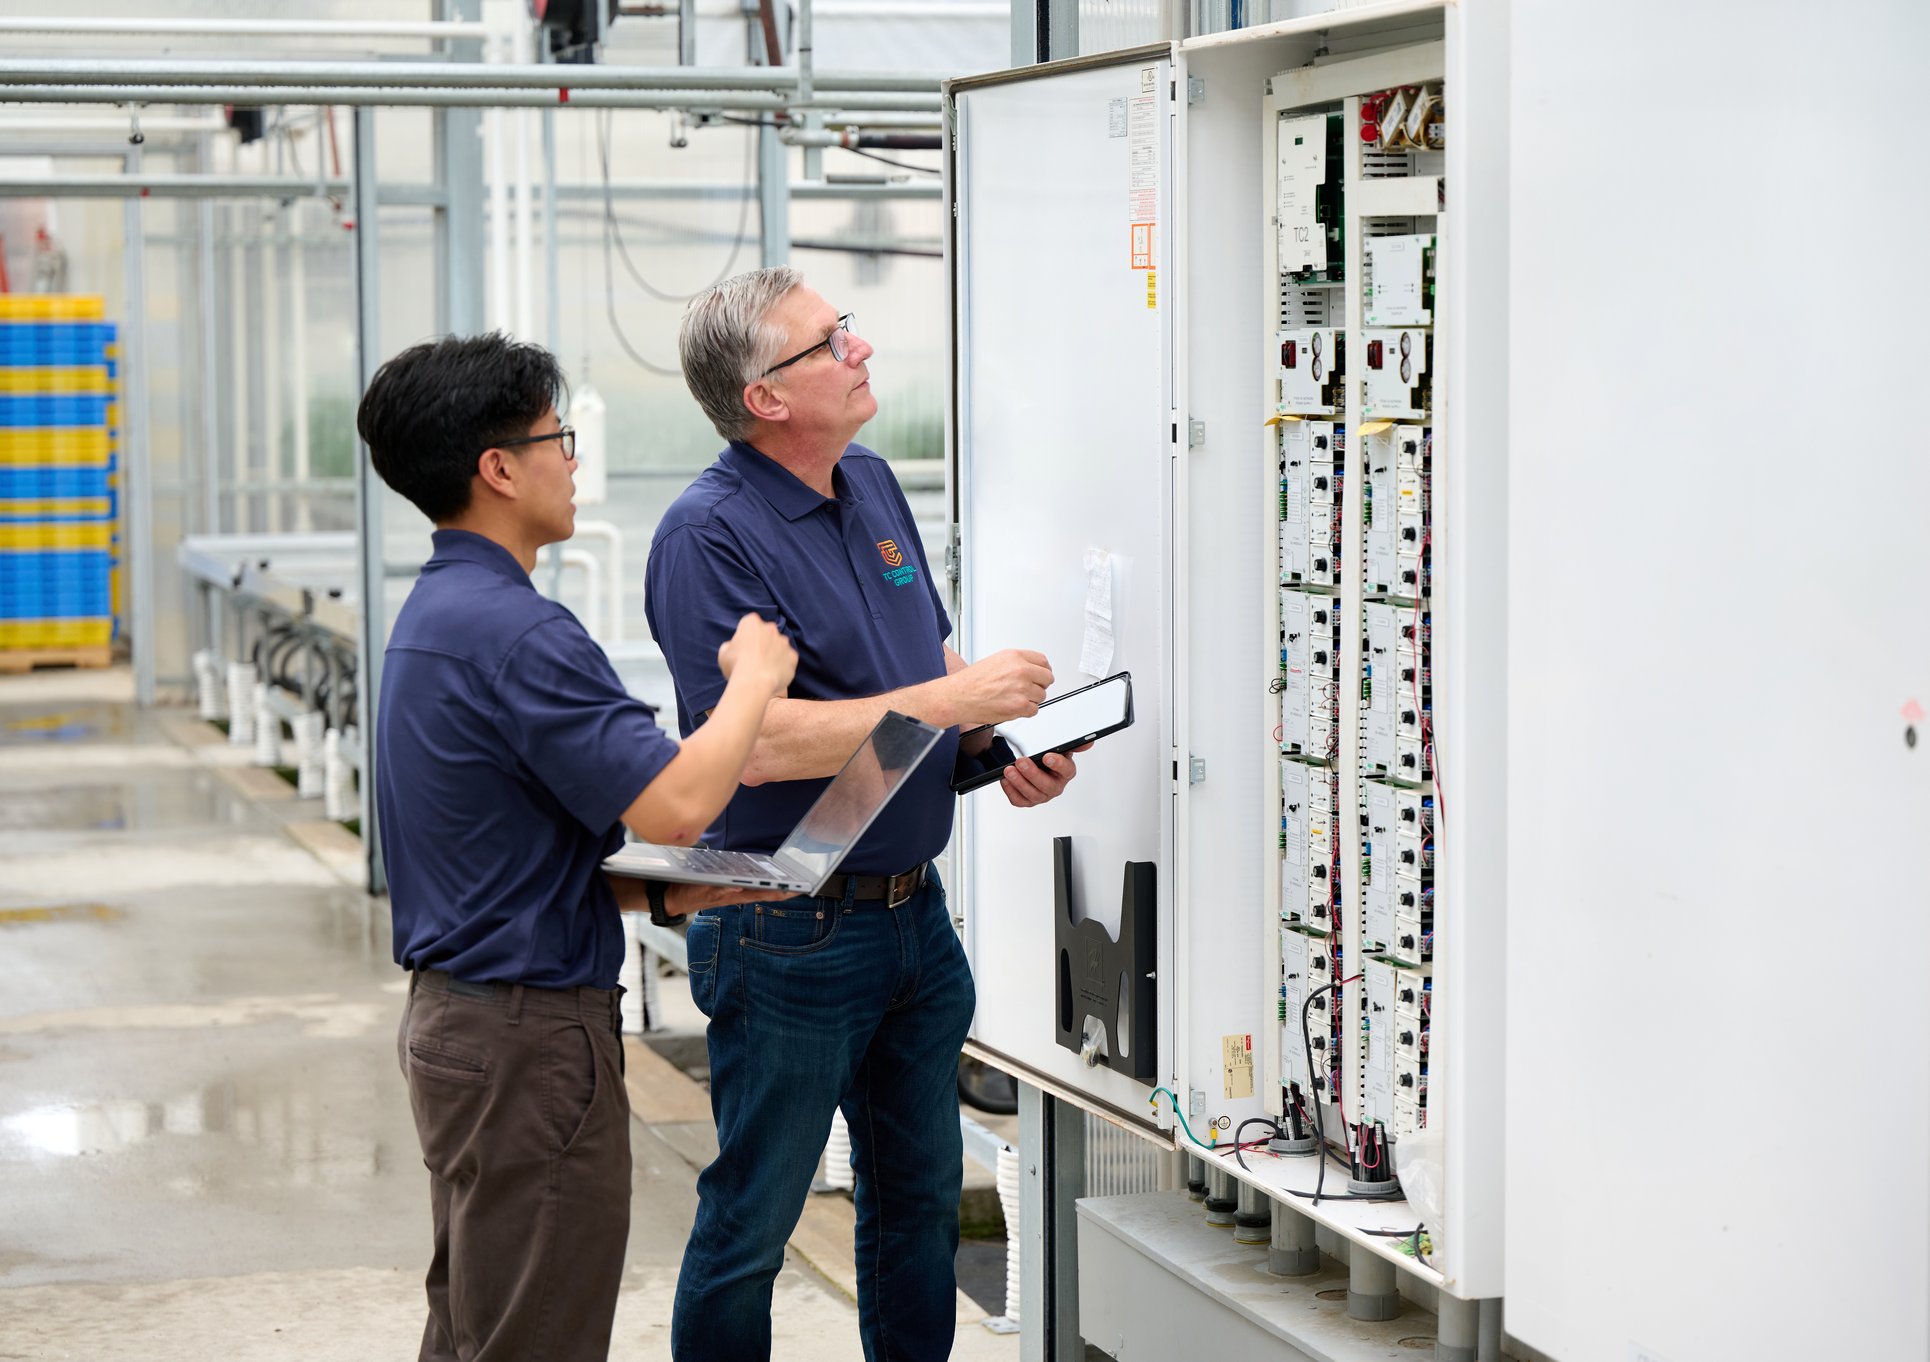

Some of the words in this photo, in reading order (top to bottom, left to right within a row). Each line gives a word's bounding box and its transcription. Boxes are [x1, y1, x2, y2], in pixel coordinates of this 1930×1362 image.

[1293, 226, 1309, 243] TC2
[882, 572, 893, 581] TC
[894, 574, 914, 587] GROUP
